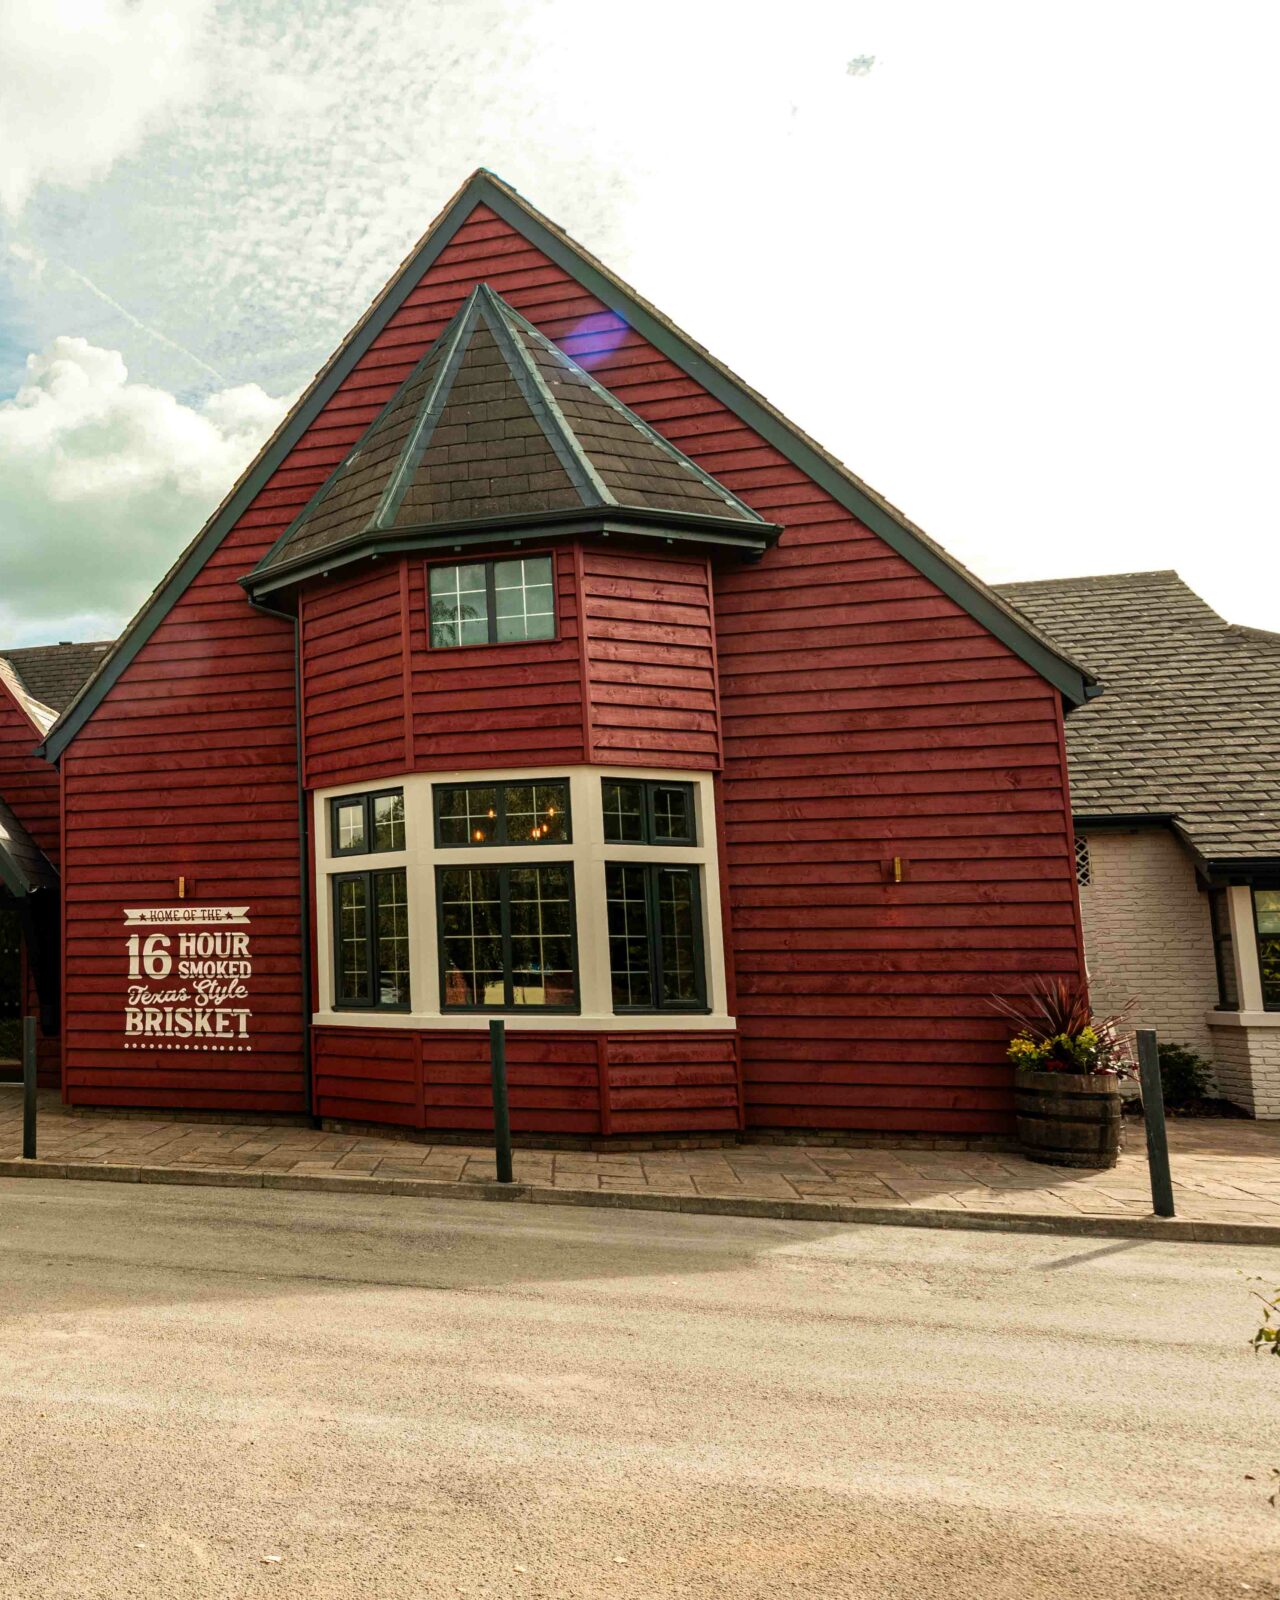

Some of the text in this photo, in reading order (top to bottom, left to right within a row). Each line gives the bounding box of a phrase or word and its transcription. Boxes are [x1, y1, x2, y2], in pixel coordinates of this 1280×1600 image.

[150, 909, 223, 922] HOME OF THE
[125, 932, 252, 980] 16 HOUR
[178, 961, 252, 979] SMOKED
[127, 978, 248, 1006] Texas Style
[124, 1007, 252, 1038] BRISKET
